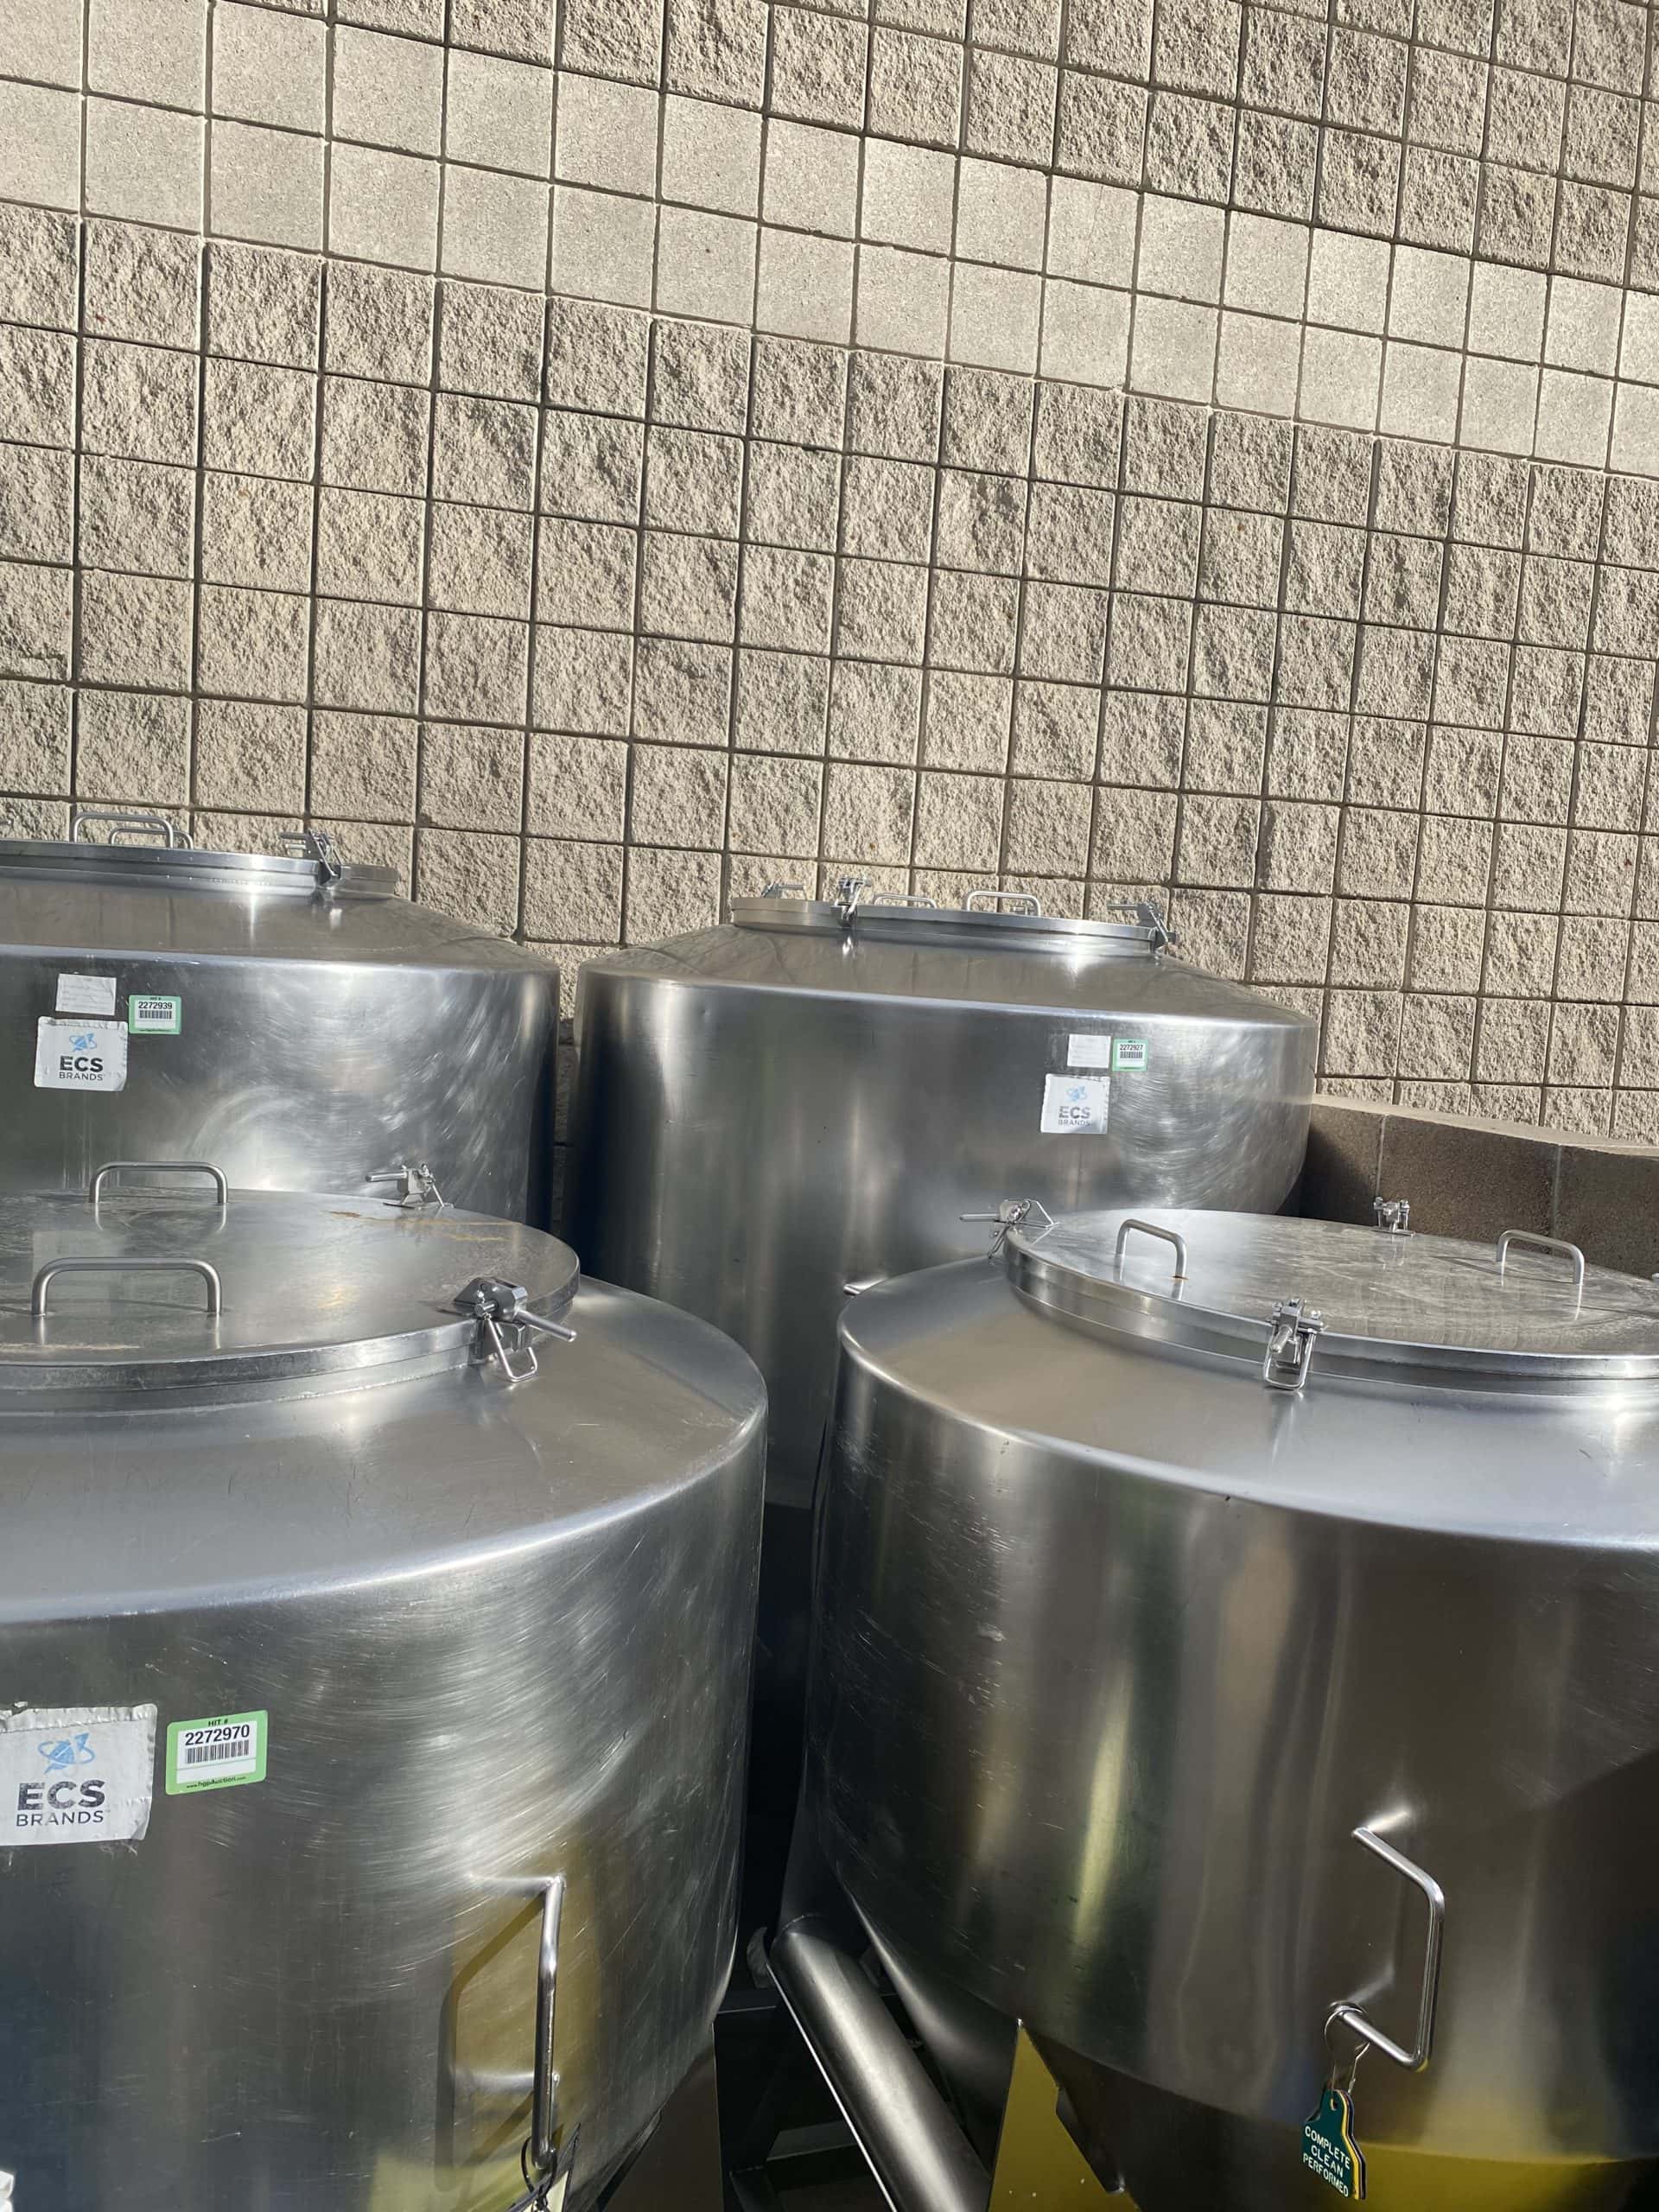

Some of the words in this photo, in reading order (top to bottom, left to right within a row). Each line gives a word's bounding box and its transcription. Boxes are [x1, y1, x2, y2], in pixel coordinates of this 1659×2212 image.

[138, 1001, 173, 1010] 2272939
[60, 1055, 104, 1072] ECS
[60, 1071, 104, 1081] BRANDS
[1058, 1106, 1090, 1119] ECS
[185, 1725, 249, 1746] 2272970
[17, 1780, 105, 1811] ECS
[16, 1811, 105, 1827] BRANDS
[1305, 2126, 1351, 2170] COMPLETE
[1311, 2145, 1343, 2178] CLEAN
[1303, 2153, 1348, 2197] PERFORMED
